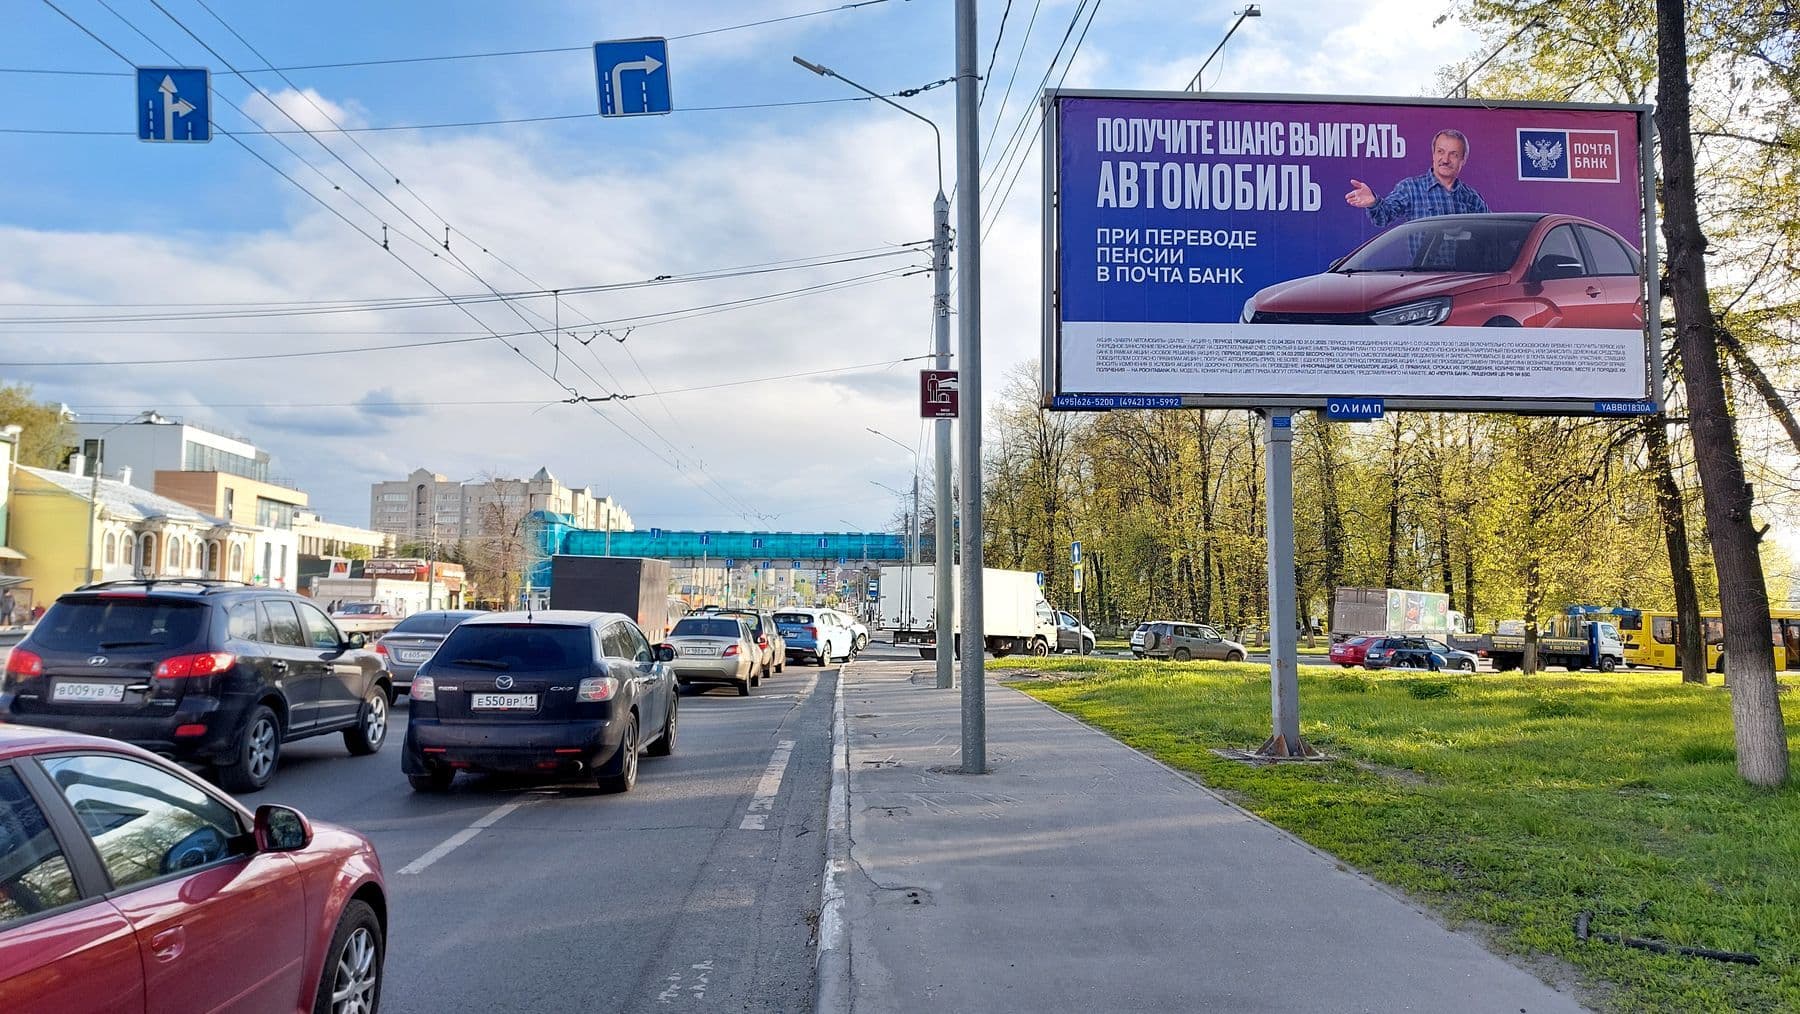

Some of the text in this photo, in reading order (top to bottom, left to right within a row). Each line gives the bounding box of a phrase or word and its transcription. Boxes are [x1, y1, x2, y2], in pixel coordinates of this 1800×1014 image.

[1097, 118, 1406, 159] ПОЛУЧИТЕ ШАНС ВЫИГРАТЬ
[1574, 143, 1612, 155] ПОЧТА
[1575, 157, 1607, 168] БАНК
[1097, 160, 1322, 212] АВТОМОБИЛЬ
[1097, 228, 1257, 249] ПРИ ПЕРЕВОДЕ
[1097, 248, 1184, 264] ПЕНСИИ
[1097, 266, 1244, 284] В ПОЧТА БАНК
[1057, 398, 1179, 407] (495)626-5200 (4942) 31-5992
[1330, 404, 1381, 414] ОЛИМП
